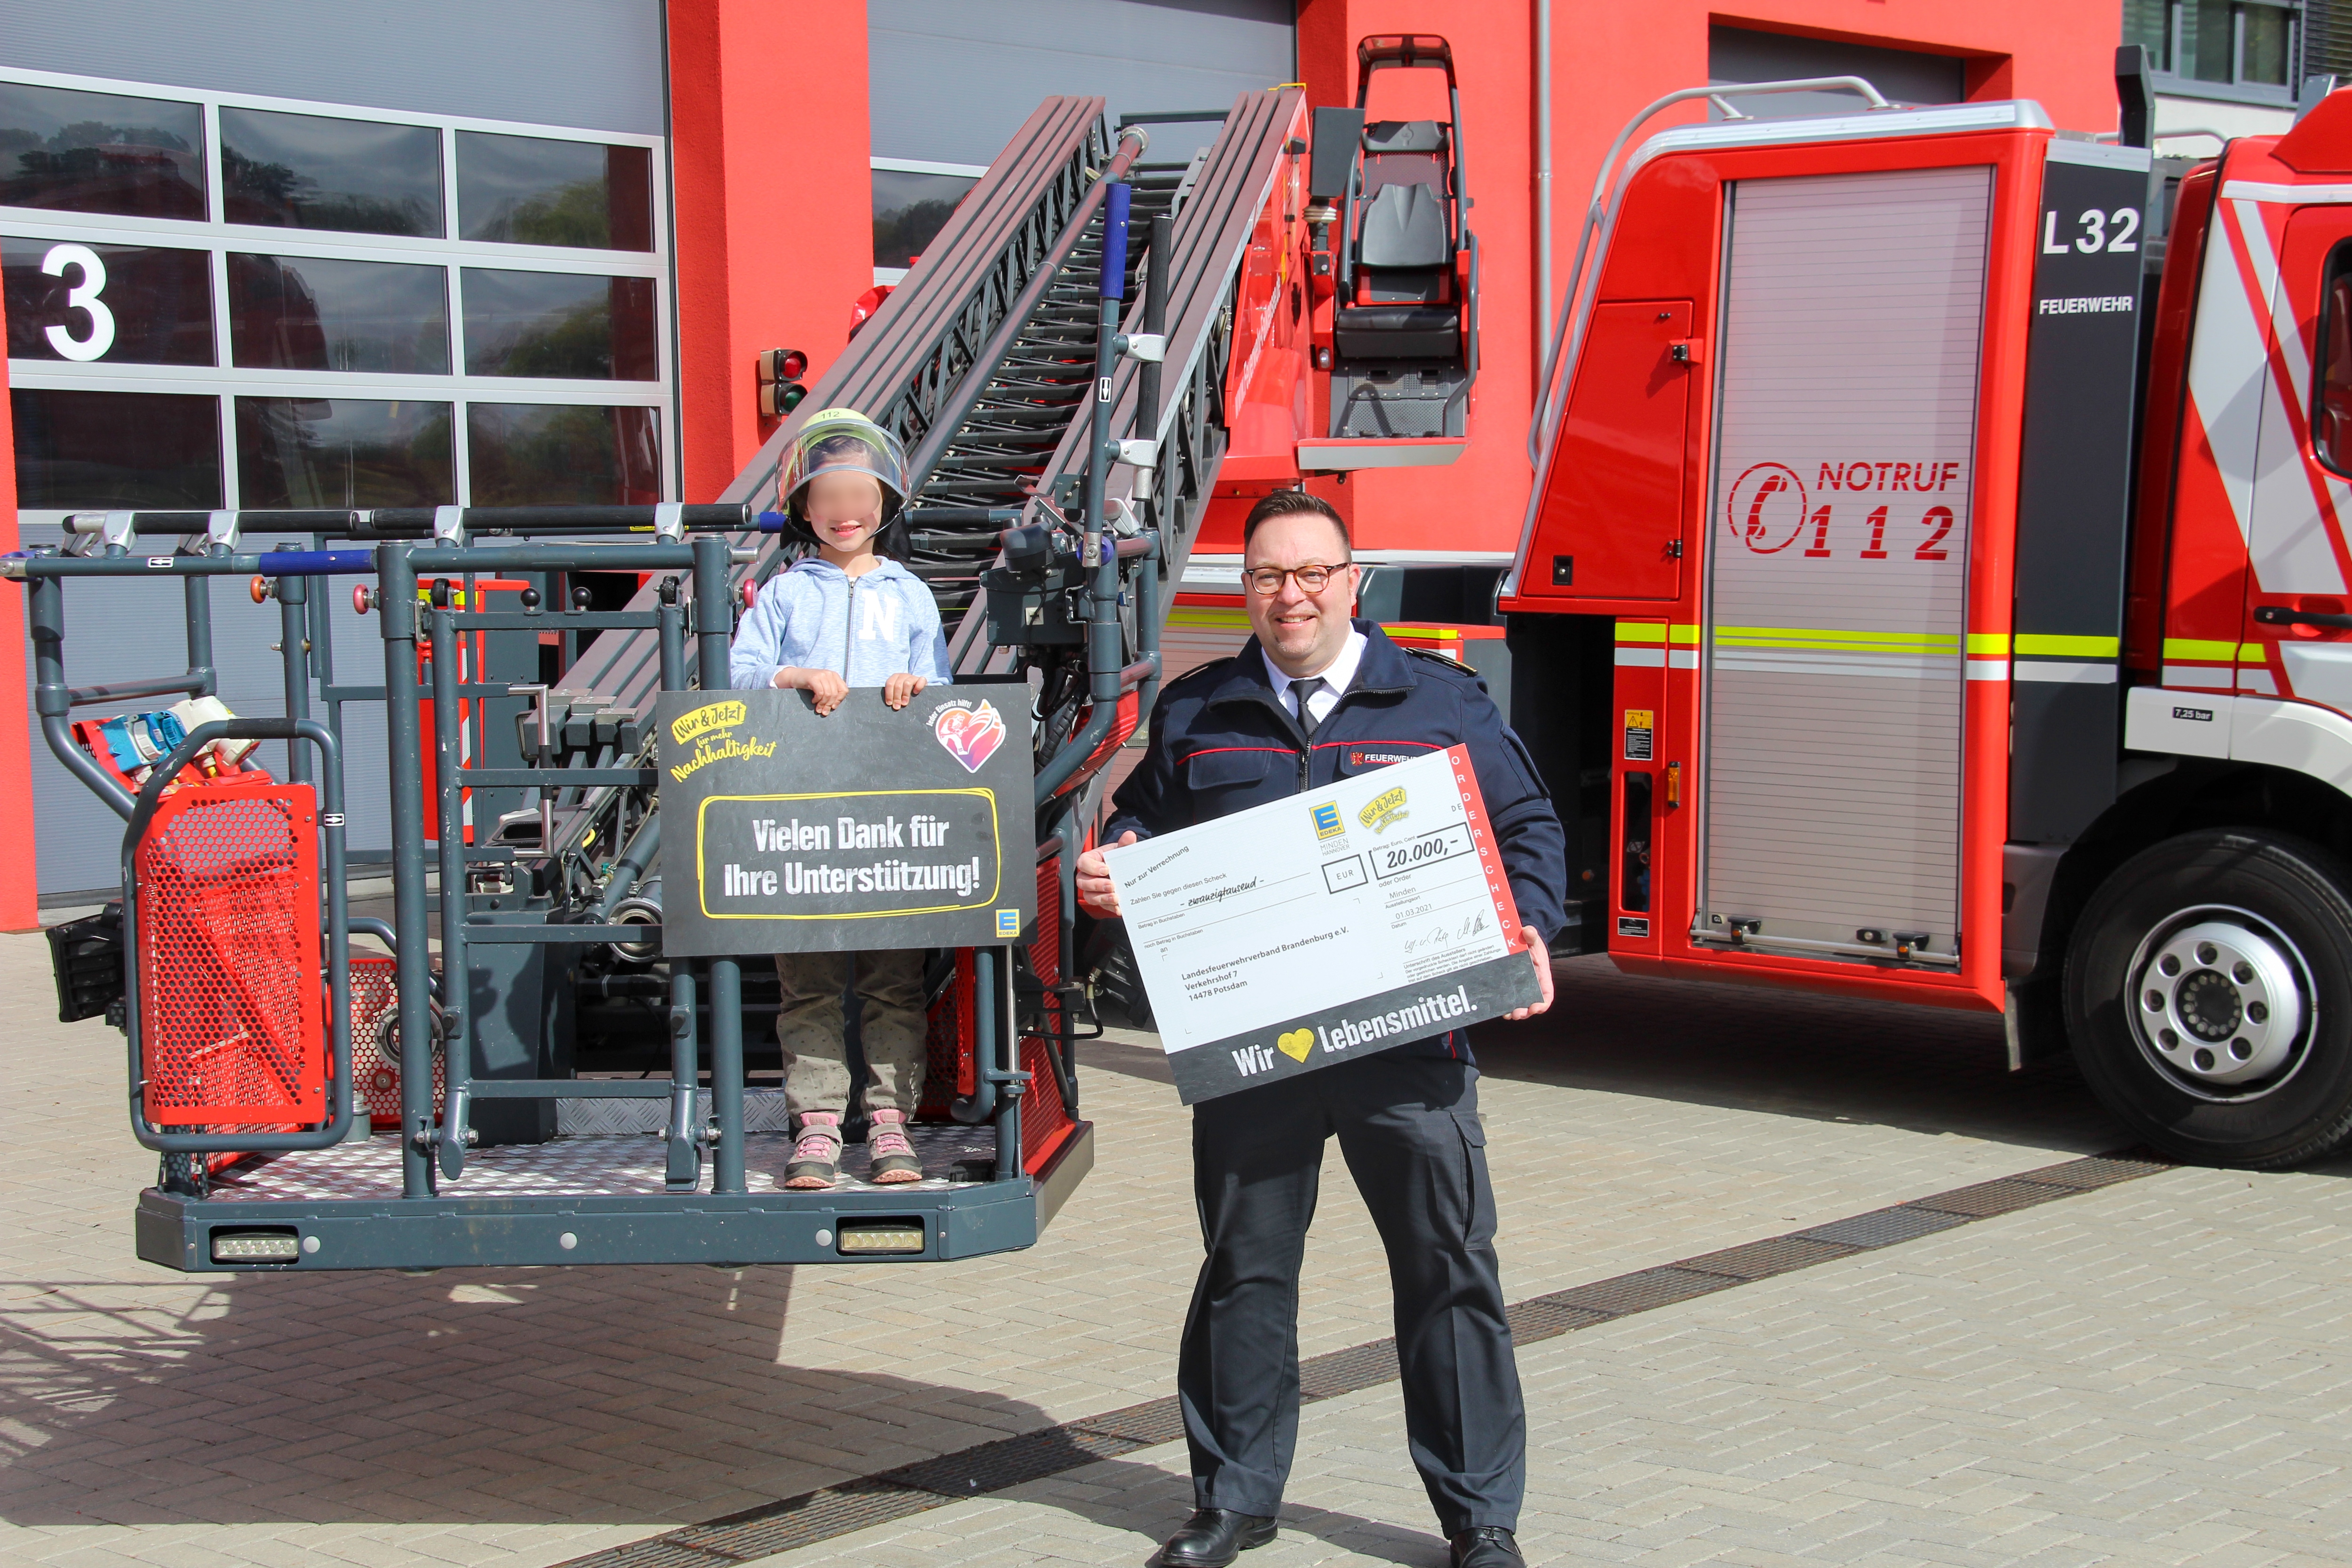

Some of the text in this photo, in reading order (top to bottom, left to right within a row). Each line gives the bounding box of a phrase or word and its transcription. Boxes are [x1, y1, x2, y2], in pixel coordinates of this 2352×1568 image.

[2042, 207, 2140, 254] L 32
[41, 243, 116, 362] 3
[2039, 295, 2133, 315] FEUERWEHR
[1817, 462, 1959, 492] NOTRUF
[858, 590, 898, 642] N
[674, 704, 743, 739] Wir & Jetzt
[926, 699, 972, 727] Jeder Einsatz hilft!
[2175, 708, 2211, 720] 7,25 bar
[696, 728, 733, 748] für mehr
[670, 736, 777, 783] Nachhaltigkeit
[1360, 807, 1376, 824] Wir
[1381, 789, 1403, 808] Jetzt
[752, 814, 950, 852] Vielen Dank für
[1319, 827, 1343, 836] EDEKA
[1320, 837, 1349, 852] MINDEN
[1322, 844, 1351, 856] HANNOVER
[1373, 844, 1391, 852] Betrag:
[1391, 839, 1404, 848] Euro,
[724, 856, 980, 897] Ihre Unterstützung!
[1124, 845, 1190, 888] Nur zur Verrechnung
[1336, 869, 1355, 880] EUR
[1130, 873, 1227, 905] Zahlen Sie gegen diesen Scheck
[1394, 874, 1412, 883] Order
[1385, 895, 1421, 909] Ausstellungsort
[1389, 887, 1416, 899] Minden
[1138, 920, 1153, 930] Betrag
[1159, 912, 1185, 923] Buchstaben
[1395, 903, 1432, 919] 01.03.2021
[1144, 941, 1156, 949] noch
[1156, 937, 1171, 947] Betrag
[1176, 928, 1204, 940] Buchstaben
[1182, 926, 1349, 980] Landesfeuerwehrverband Brandenburg e.V.
[1404, 958, 1431, 970] Unterschrift
[1441, 948, 1466, 959] Ausstellers
[1184, 971, 1232, 991] Verkehrshof
[1188, 980, 1248, 1002] 14478 Potsdam
[1231, 985, 1478, 1077] Wir Lebensmittel.
